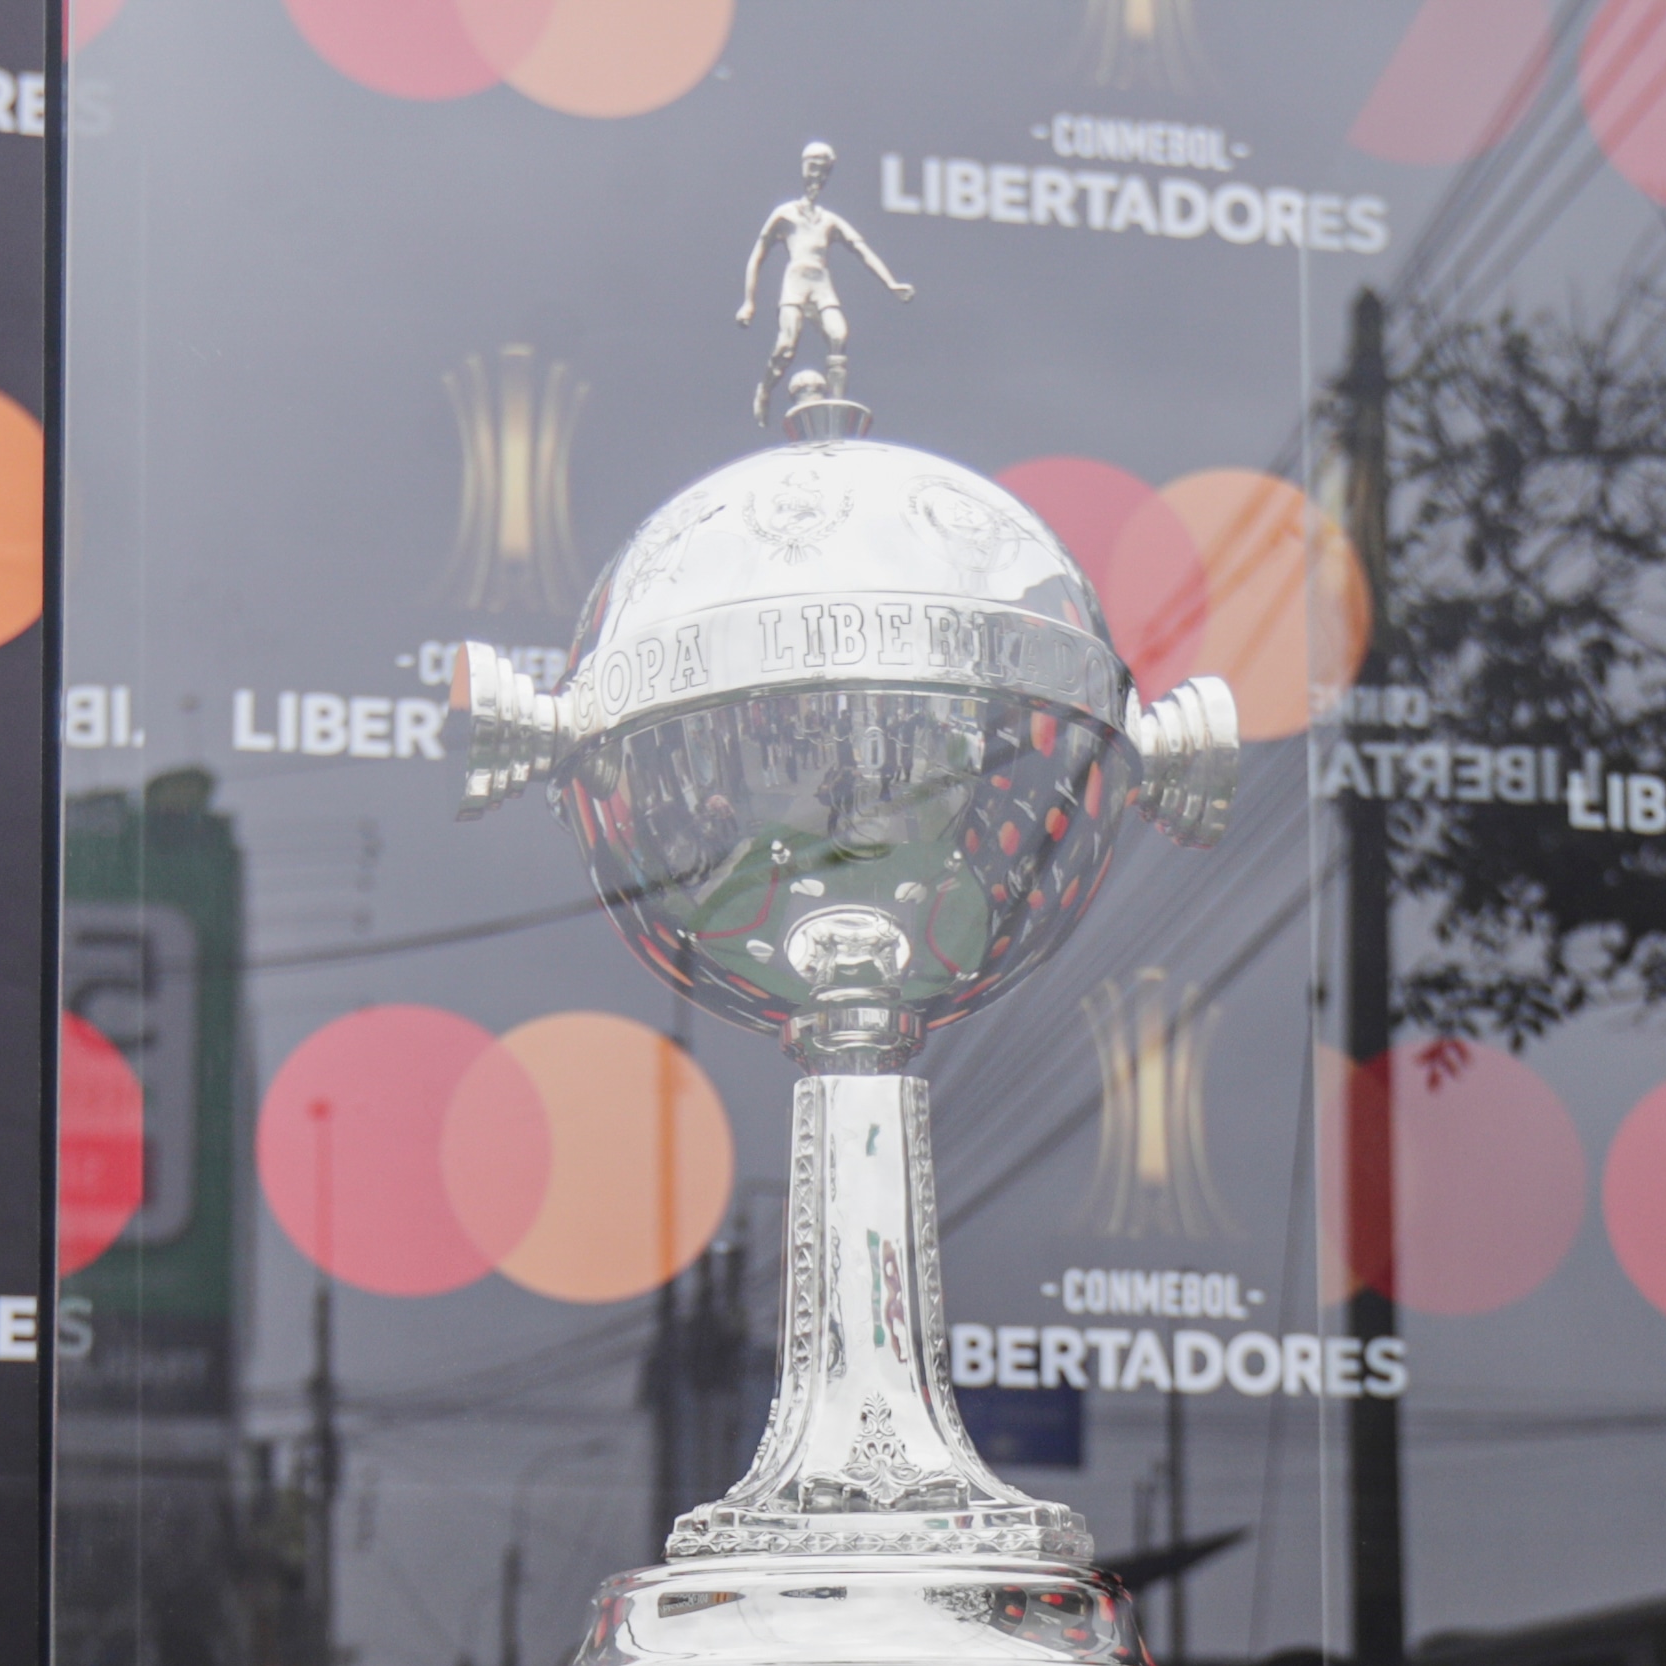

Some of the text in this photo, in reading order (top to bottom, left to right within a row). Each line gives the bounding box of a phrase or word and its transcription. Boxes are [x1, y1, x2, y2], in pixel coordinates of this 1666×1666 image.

[881, 153, 1389, 254] LIBERTADORES
[571, 622, 711, 738] COPA
[759, 600, 1123, 718] LIBERTADO
[233, 689, 447, 760] LIBER
